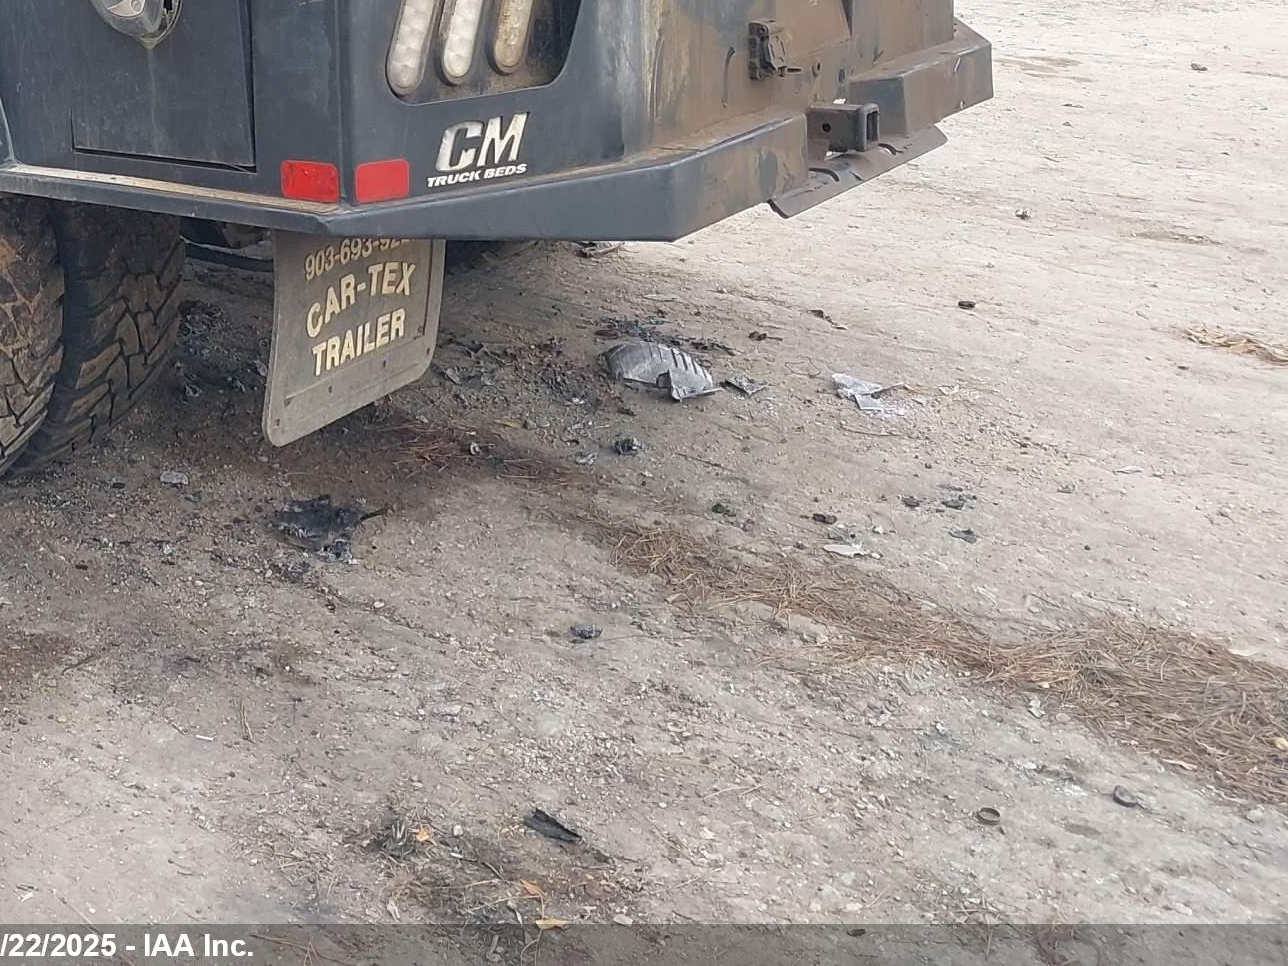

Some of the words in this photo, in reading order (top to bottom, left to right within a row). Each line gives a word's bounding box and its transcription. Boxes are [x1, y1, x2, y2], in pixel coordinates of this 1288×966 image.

[435, 112, 529, 171] CM
[427, 170, 482, 187] TRUCK
[483, 163, 528, 179] BEDS
[304, 238, 410, 281] 903-693-
[306, 261, 416, 338] CAR-TEX
[312, 308, 405, 376] TRAILER
